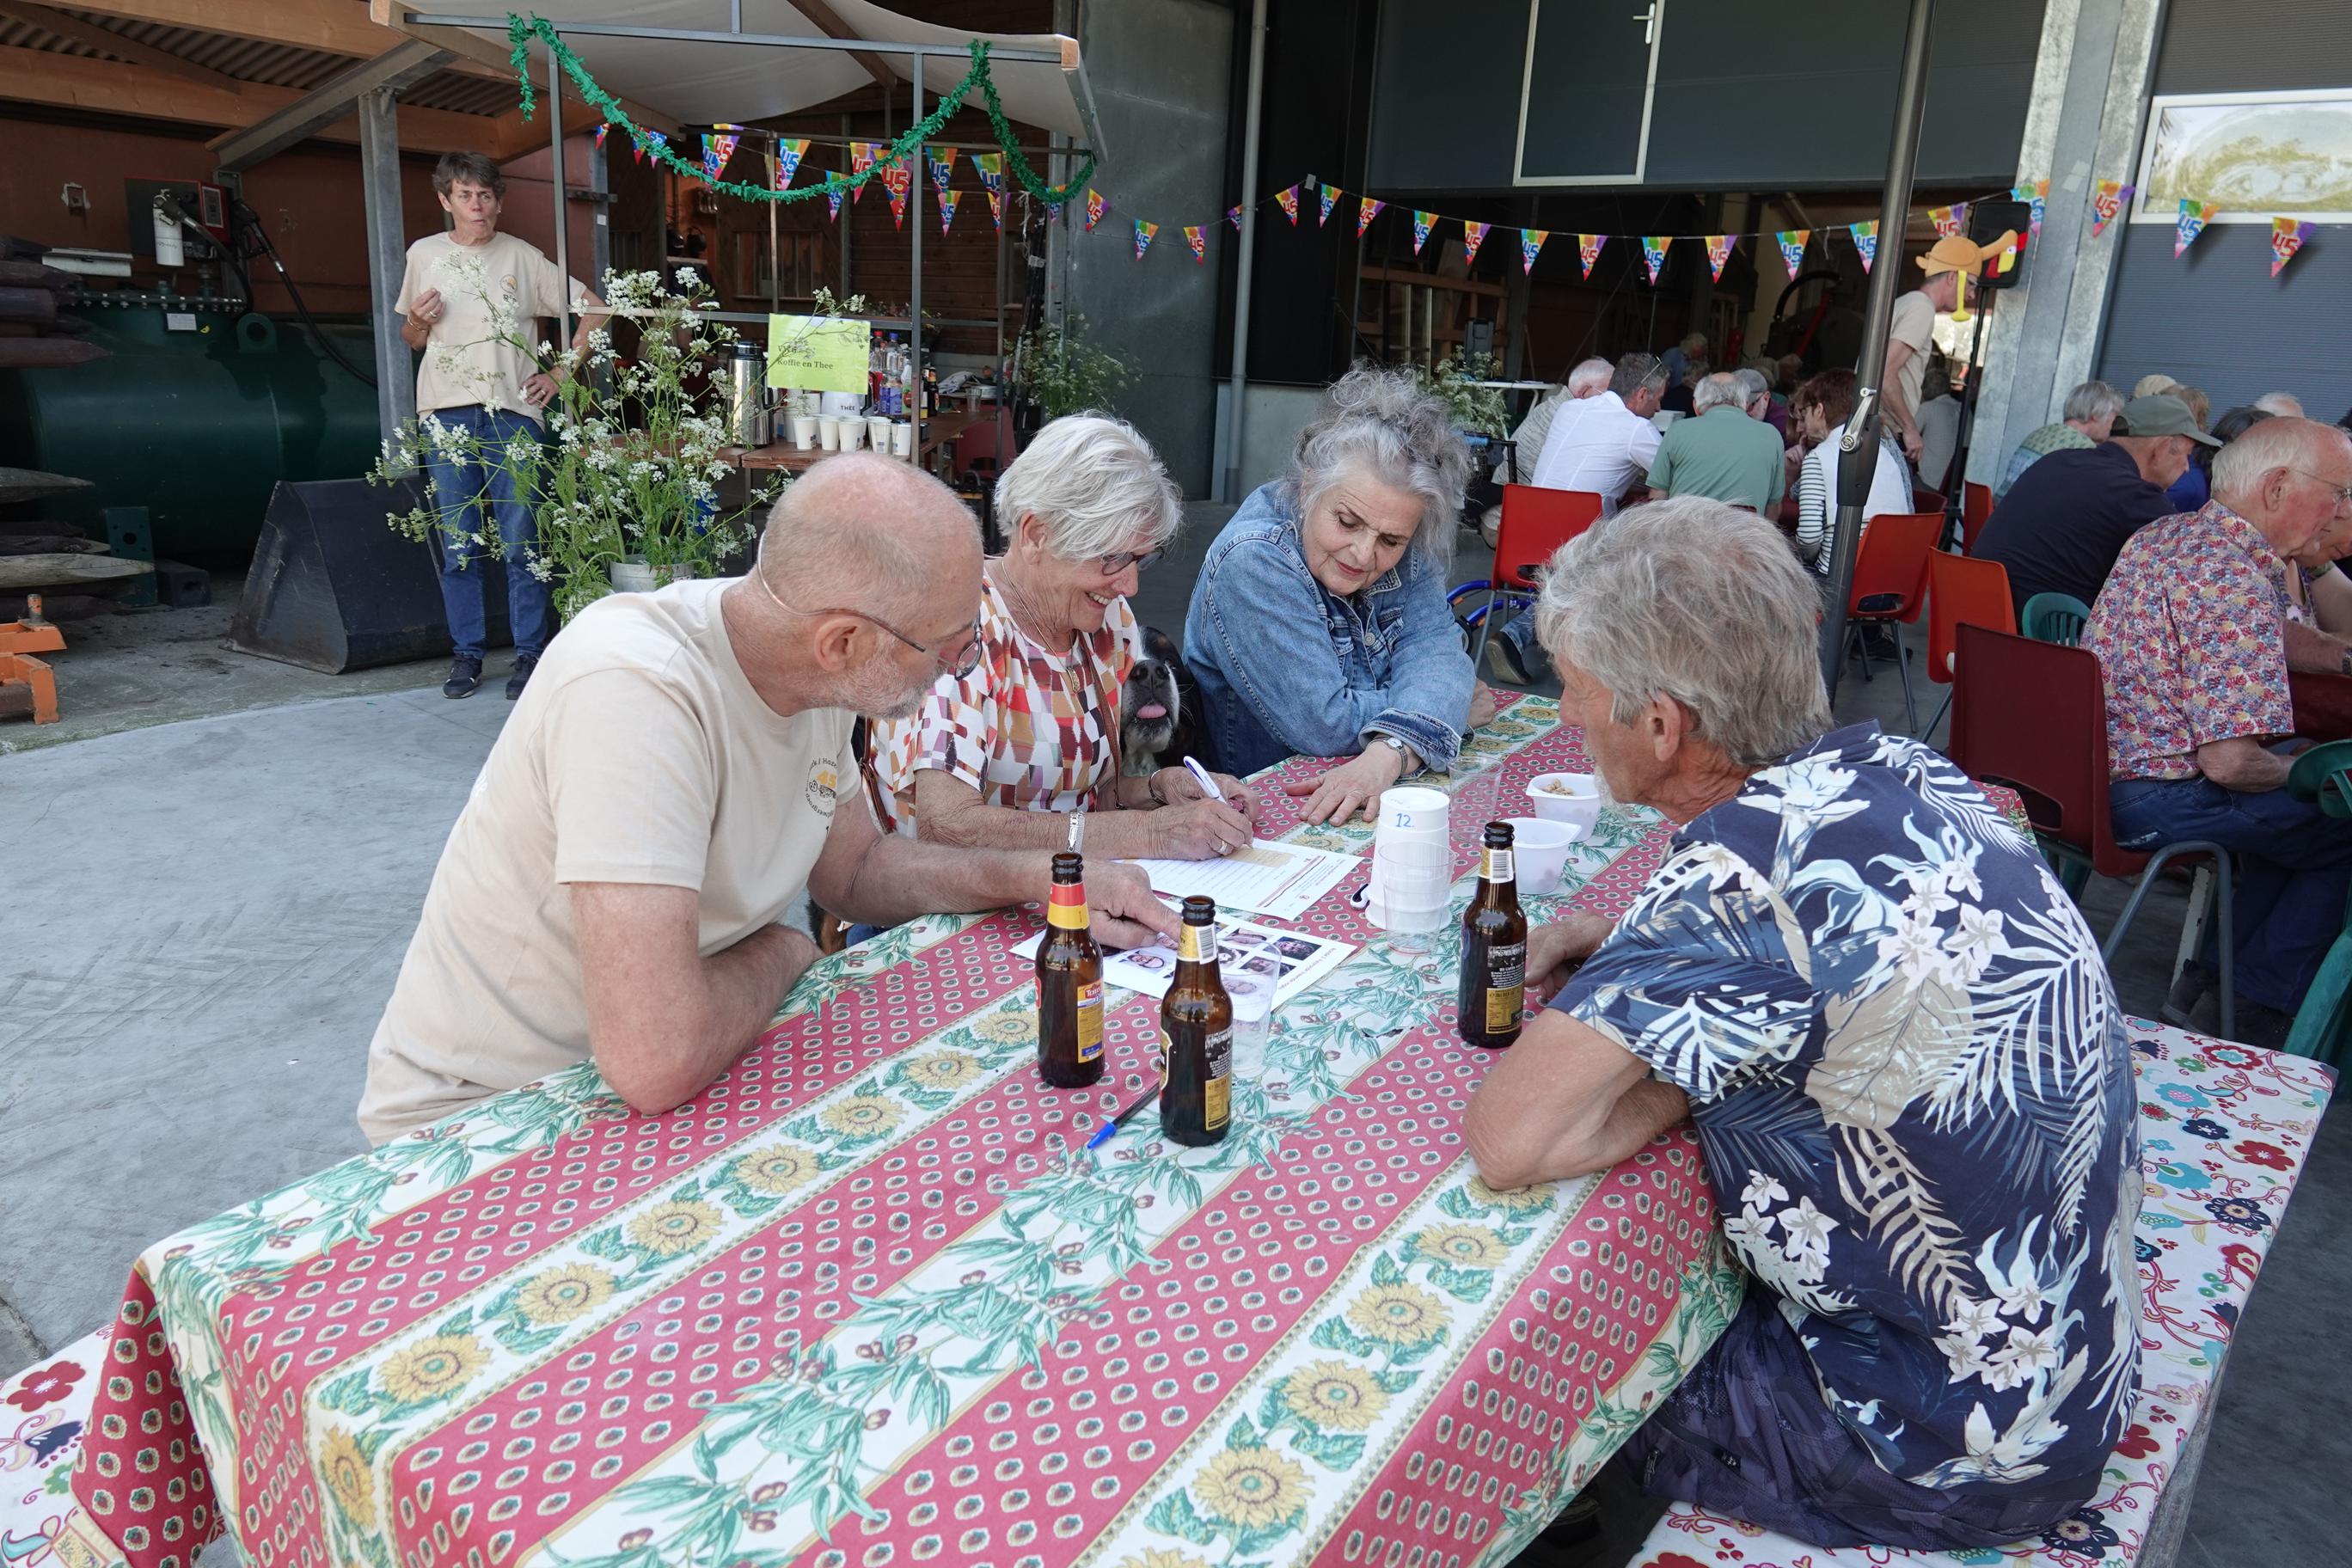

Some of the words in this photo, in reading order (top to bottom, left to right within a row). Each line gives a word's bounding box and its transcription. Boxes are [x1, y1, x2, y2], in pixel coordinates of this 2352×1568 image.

[714, 138, 733, 163] 45
[780, 147, 799, 174] 45
[881, 167, 909, 195] 45
[928, 159, 950, 187] 45
[1087, 200, 1102, 224] 45
[1282, 199, 1297, 215] 45
[1321, 193, 1332, 214] 45
[2095, 193, 2119, 220] 45
[1360, 206, 1375, 225] 45
[1414, 221, 1430, 242] 45
[2177, 213, 2202, 241] 45
[1136, 229, 1149, 250] 45
[1189, 236, 1204, 253] 45
[1466, 233, 1482, 251] 45
[1522, 240, 1539, 260] 45
[1856, 235, 1876, 254] 45
[2272, 231, 2299, 258] 45
[1581, 244, 1600, 265] 45
[1645, 248, 1664, 268] 45
[1708, 247, 1730, 266] 45
[1782, 243, 1803, 263] 45
[777, 358, 800, 367] Koffie
[814, 361, 833, 370] Thee
